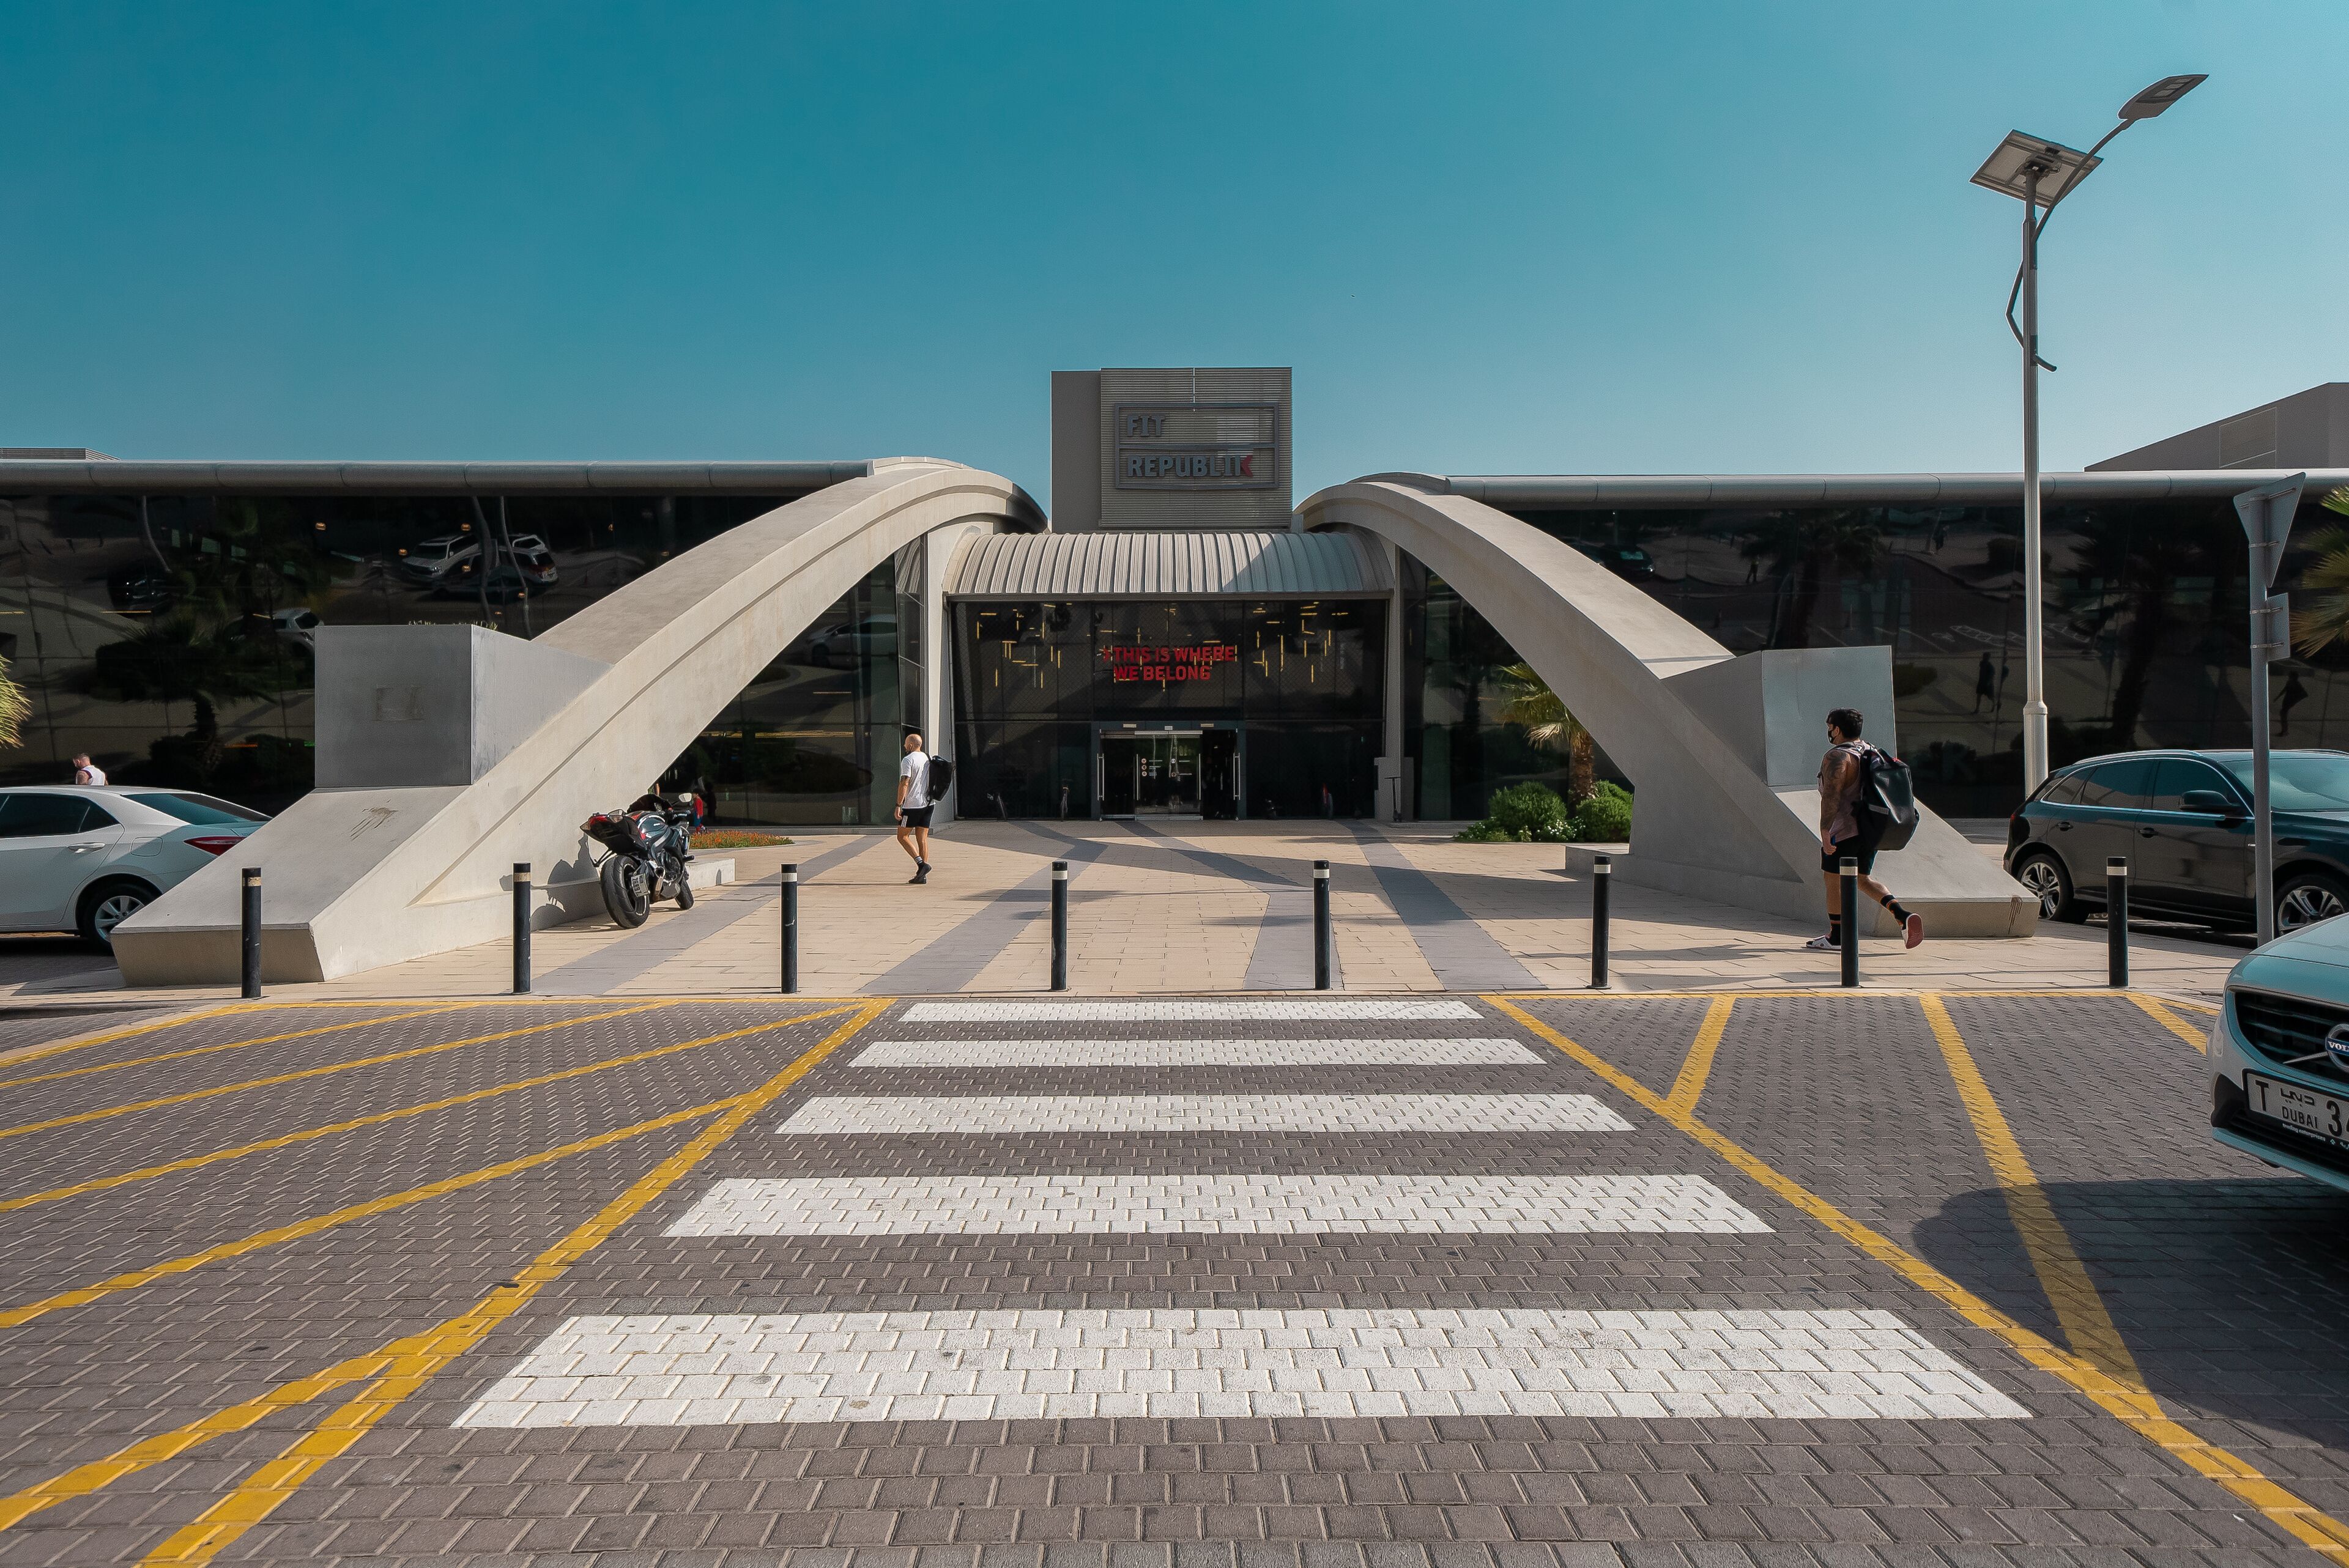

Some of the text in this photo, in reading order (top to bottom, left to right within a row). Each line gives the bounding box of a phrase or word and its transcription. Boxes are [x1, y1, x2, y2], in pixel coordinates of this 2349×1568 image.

[1126, 414, 1165, 437] FIT
[1113, 646, 1234, 662] THIS IS WHERE
[1114, 665, 1211, 680] WE BELONG
[2255, 1079, 2269, 1112] T
[2280, 1087, 2316, 1108] دبي
[2282, 1105, 2318, 1129] DUBAI
[2326, 1100, 2349, 1137] 3
